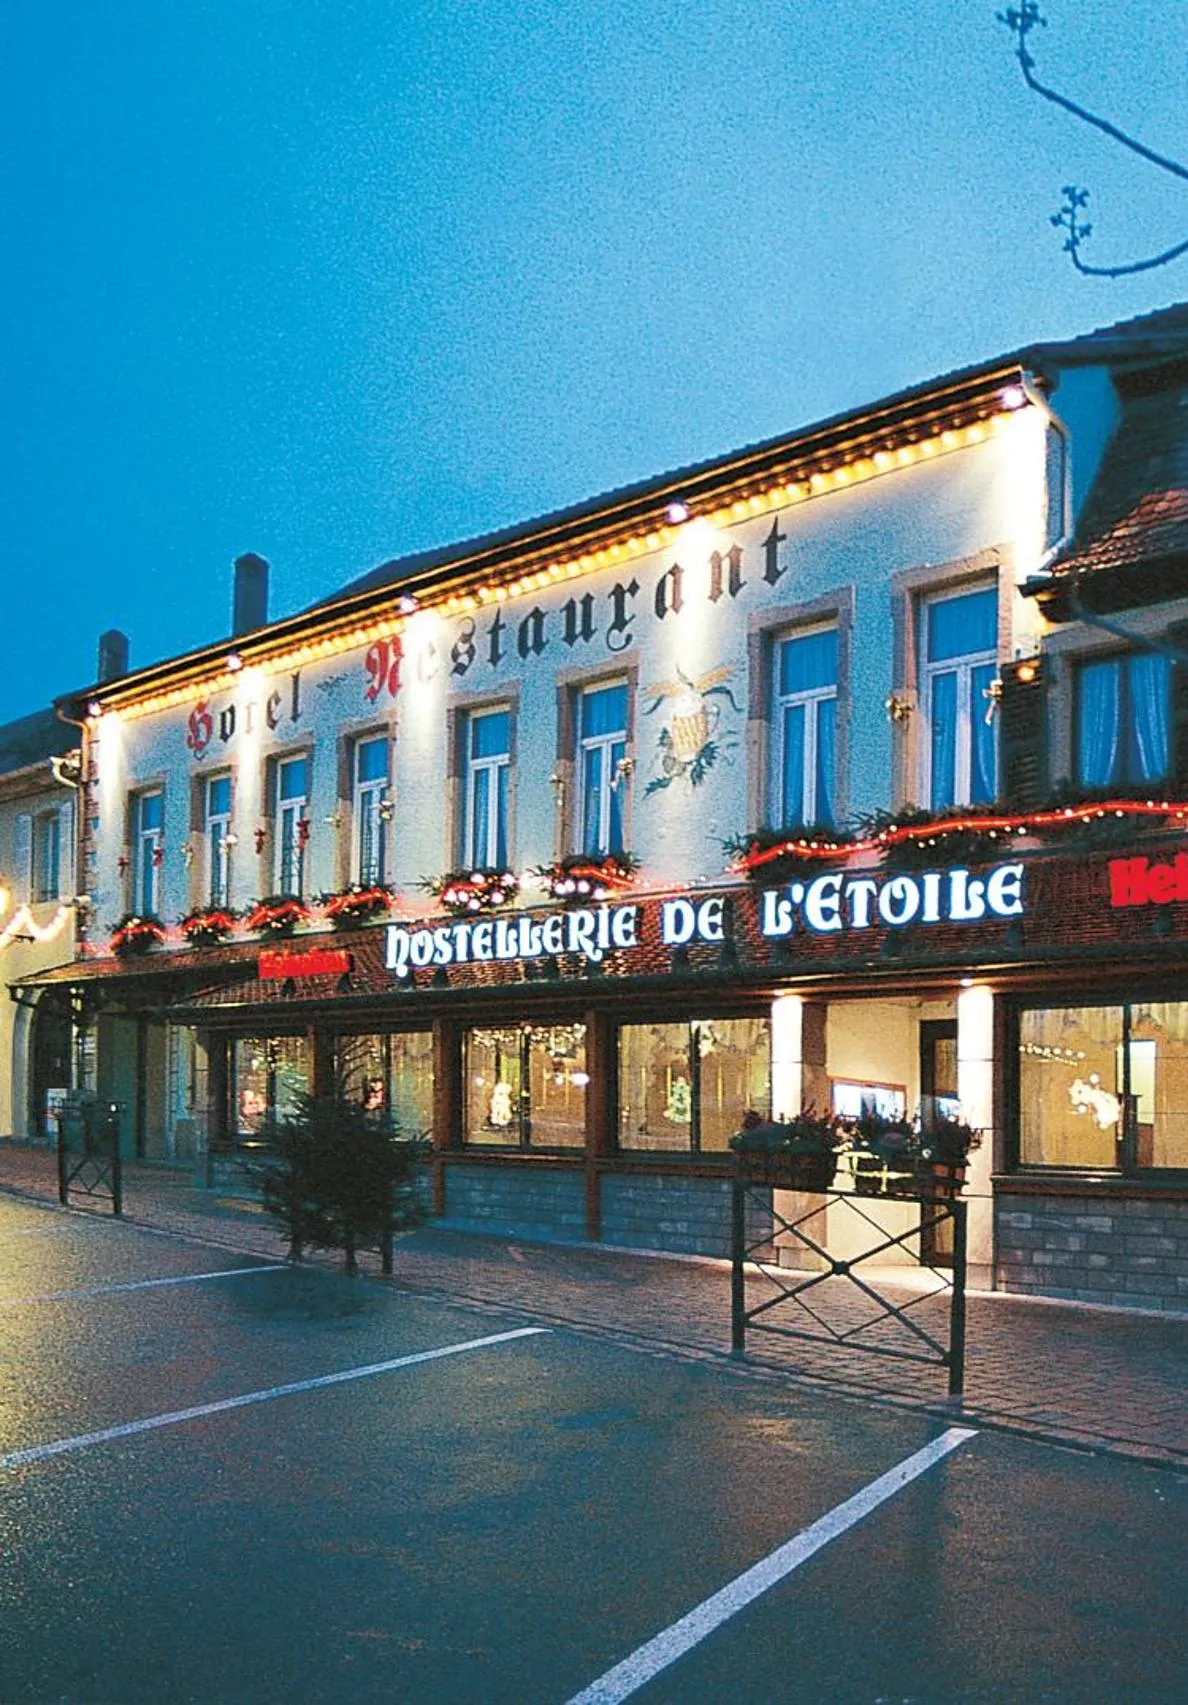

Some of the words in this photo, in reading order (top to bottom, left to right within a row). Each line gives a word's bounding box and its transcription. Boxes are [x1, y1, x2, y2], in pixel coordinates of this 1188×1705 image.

[364, 516, 788, 702] Restaurant
[386, 902, 639, 977] HOSTELLERIE
[664, 896, 725, 942] DE
[763, 863, 1025, 936] L'ETOILE
